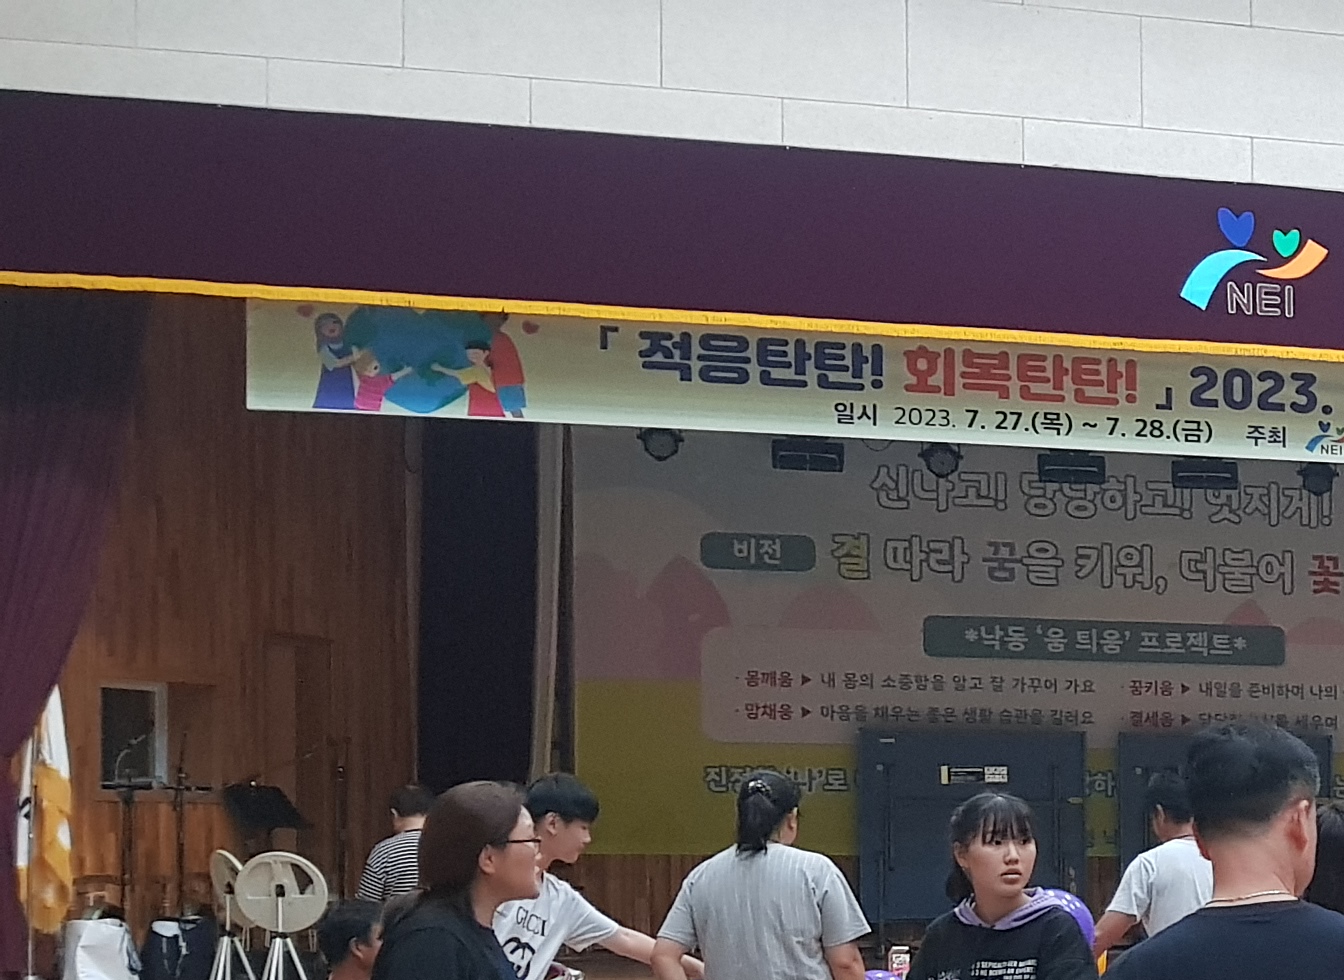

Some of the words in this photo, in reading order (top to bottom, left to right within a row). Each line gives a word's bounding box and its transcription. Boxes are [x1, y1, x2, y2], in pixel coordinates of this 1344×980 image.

[1226, 282, 1295, 317] NEI
[638, 330, 884, 392] 적응탄탄!
[903, 345, 1138, 406] 회복탄탄!
[1190, 366, 1333, 415] 2023.
[833, 402, 878, 427] 일시
[893, 406, 957, 428] 2023.
[1245, 425, 1287, 448] 주최
[1320, 444, 1343, 455] NEI
[869, 463, 1007, 512] 신나고!
[1020, 472, 1193, 520] 당당하고!
[1205, 481, 1333, 528] 멋지게!
[733, 538, 781, 565] 비전
[831, 532, 871, 580] 결
[884, 534, 970, 582] 따라
[982, 540, 1064, 586] 꿈을
[1075, 542, 1167, 595] 키워,
[1179, 546, 1296, 595] 더불어
[1307, 554, 1344, 595] 꽃
[820, 672, 836, 689] 내
[843, 672, 874, 690] 몸의
[952, 674, 984, 692] 알고
[1012, 676, 1058, 694] 가꾸어
[1065, 678, 1096, 695] 가요
[1129, 680, 1174, 697] 꿈키움
[1199, 681, 1243, 698] 내일을
[1310, 685, 1337, 700] 나의
[820, 704, 868, 722] 마음을
[1050, 708, 1095, 726] 길러요
